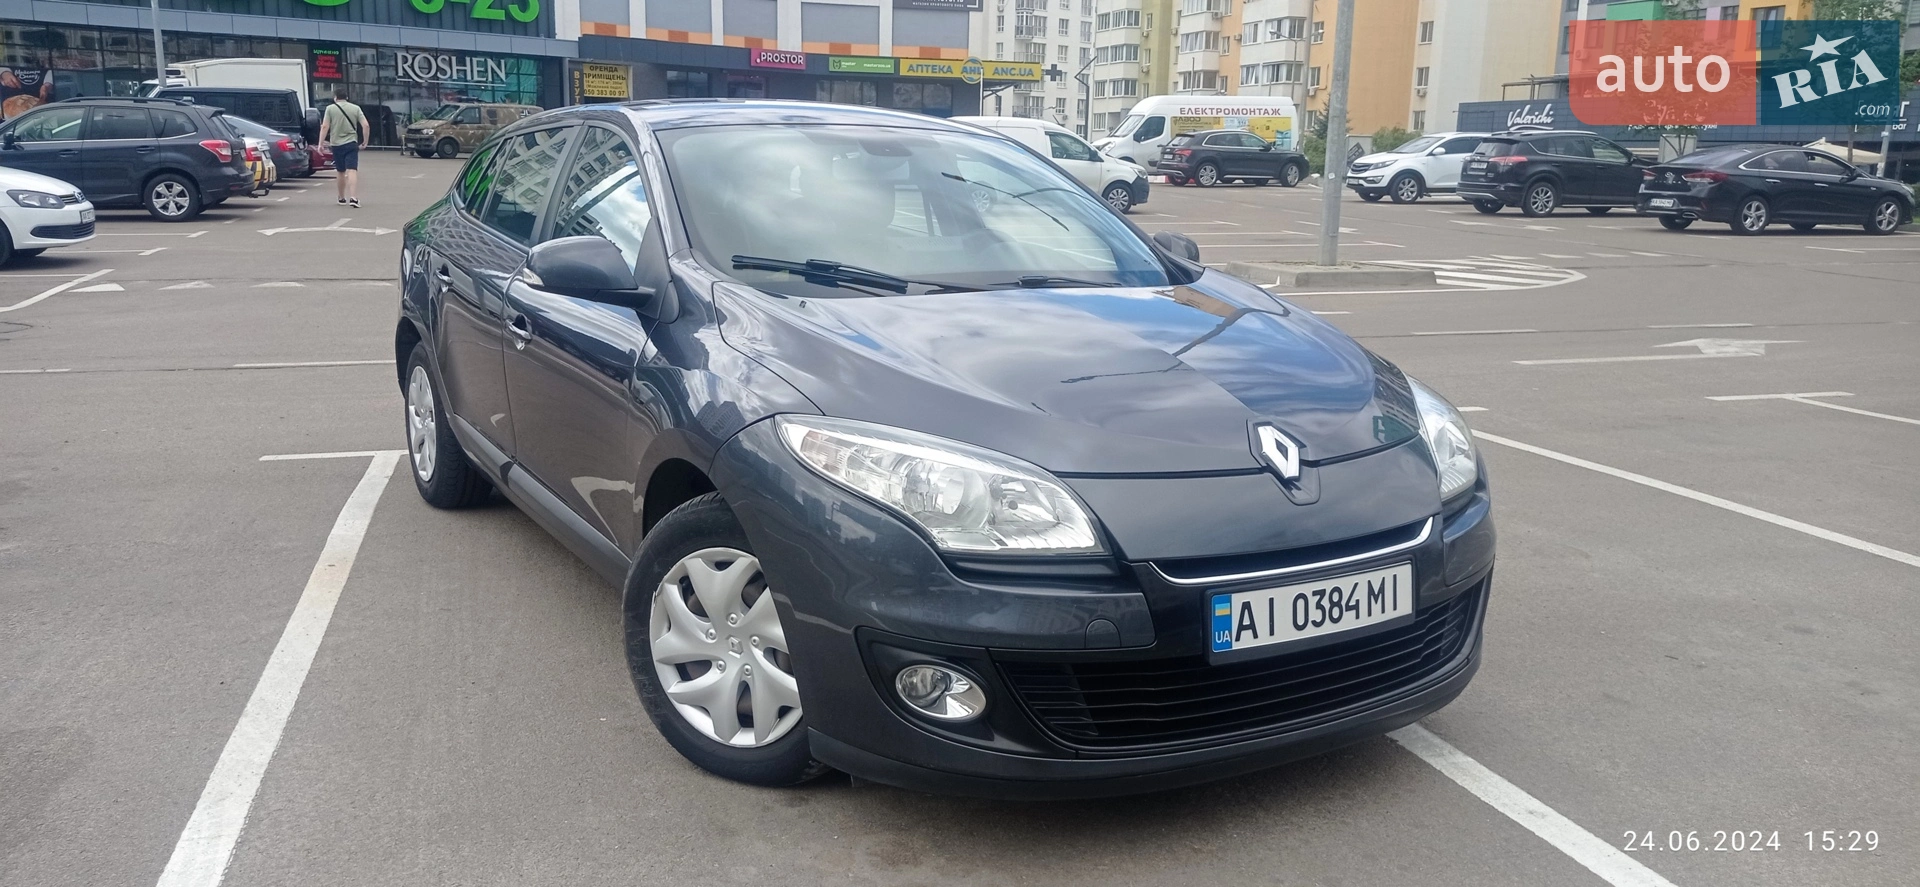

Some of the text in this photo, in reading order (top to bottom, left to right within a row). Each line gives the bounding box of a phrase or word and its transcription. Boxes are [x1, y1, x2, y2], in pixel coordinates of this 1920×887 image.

[395, 51, 506, 83] ROSHEN
[590, 65, 618, 73] ОРЕНДА
[907, 63, 953, 74] АПТЕКА
[992, 66, 1035, 77] ANC.UA
[583, 72, 626, 81] ПРИМІЩЕНЬ
[1180, 107, 1281, 116] ЕЛЕКТРОМОНТАЖ
[1507, 103, 1554, 128] Valerichi
[1235, 597, 1275, 642] AI
[1215, 630, 1231, 643] UA
